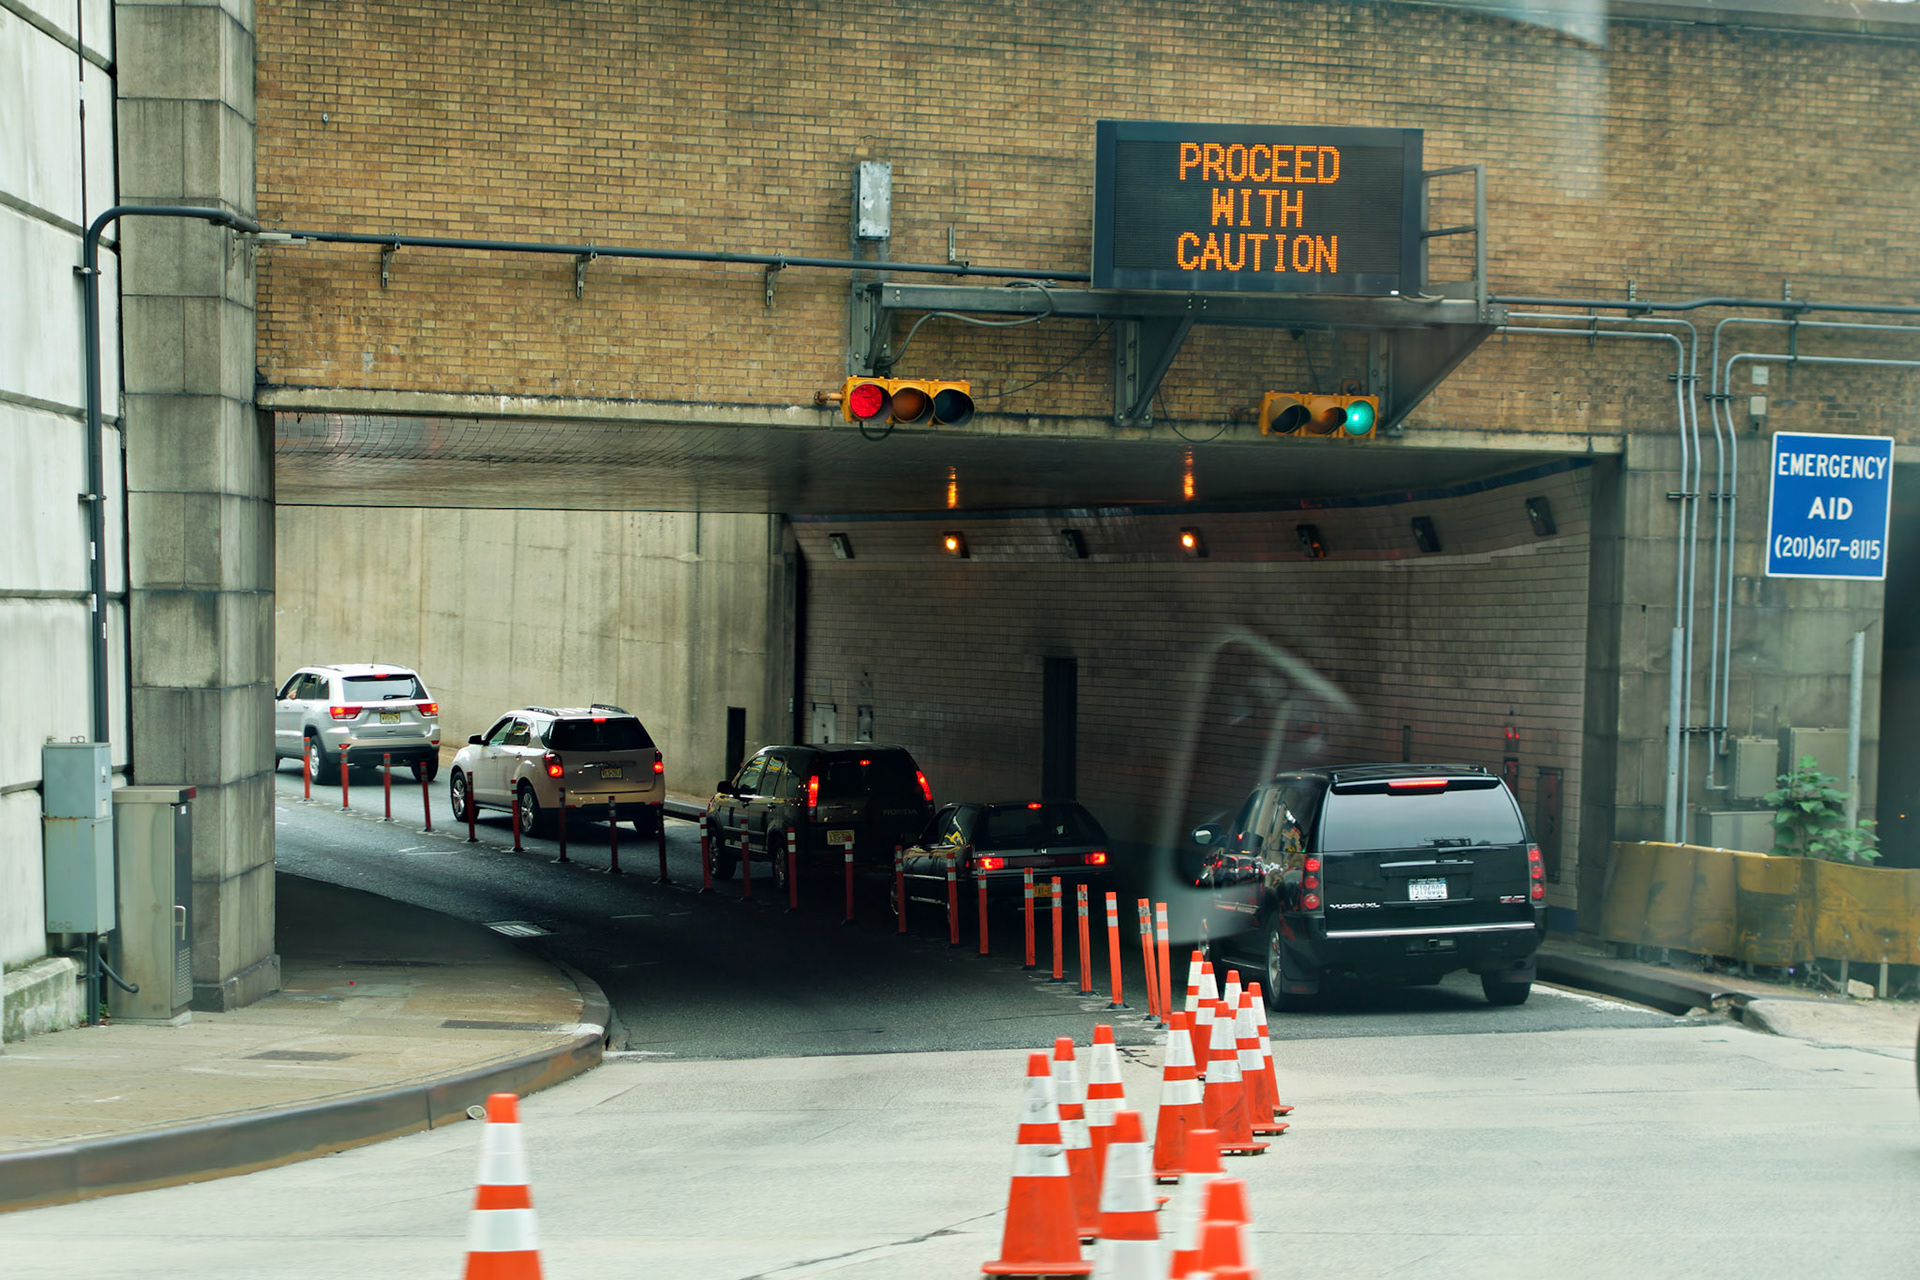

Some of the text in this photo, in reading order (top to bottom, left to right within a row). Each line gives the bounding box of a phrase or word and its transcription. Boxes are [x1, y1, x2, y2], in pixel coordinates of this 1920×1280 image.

[1180, 142, 1340, 184] PROCEED
[1211, 188, 1303, 227] WITH
[1177, 232, 1338, 273] CAUTION
[1778, 452, 1887, 480] EMERGENCY
[1807, 496, 1853, 520] AID
[1774, 534, 1881, 560] (201)617-8115
[882, 808, 919, 817] HONDA
